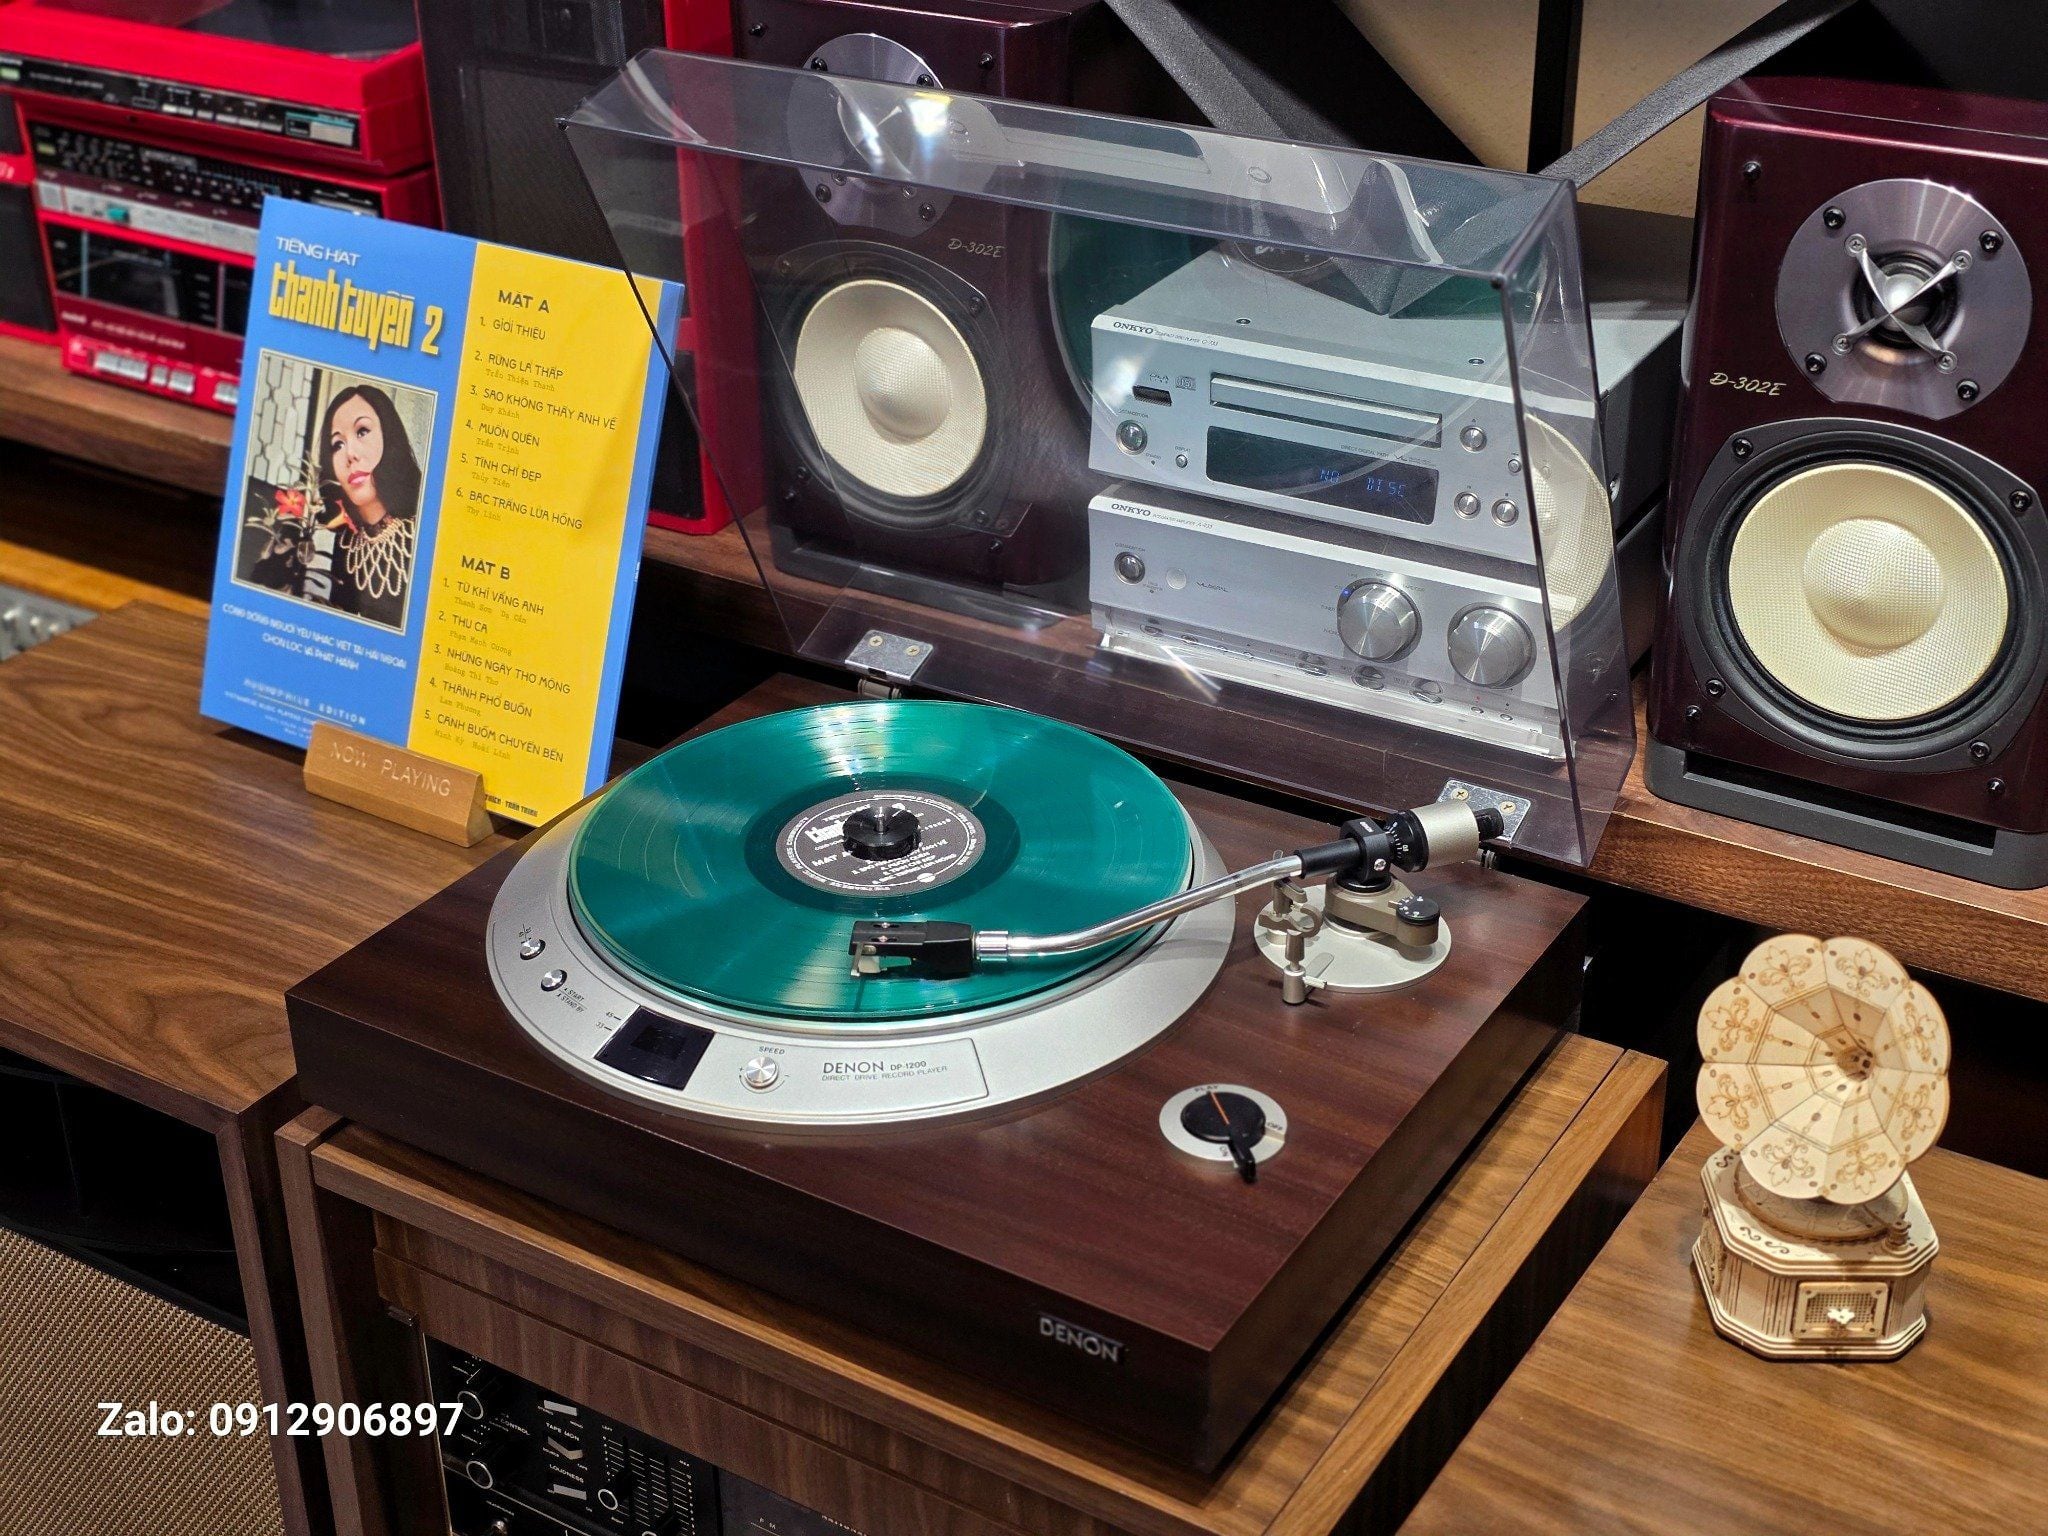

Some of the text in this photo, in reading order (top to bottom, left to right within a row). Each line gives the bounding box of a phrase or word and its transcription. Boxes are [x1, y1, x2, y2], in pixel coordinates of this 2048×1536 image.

[948, 238, 1005, 257] D-302E
[268, 259, 340, 330] thanh
[420, 305, 443, 355] 2
[538, 300, 549, 313] A
[1113, 321, 1154, 335] ONKYO
[474, 350, 483, 362] 2.
[1709, 372, 1787, 396] D-302E
[470, 385, 478, 396] 3.
[483, 388, 504, 402] SAO
[506, 393, 544, 412] KHÔNG
[577, 411, 600, 427] ANH
[465, 419, 473, 430] 4.
[461, 453, 468, 464] 5.
[456, 487, 464, 498] 6.
[1111, 503, 1151, 517] ONKYO
[500, 566, 511, 580] B
[521, 600, 544, 615] ANH
[438, 610, 488, 633] 2. THU CA
[434, 644, 441, 654] 3.
[429, 677, 437, 688] 4.
[319, 703, 366, 725] EDITION
[425, 709, 432, 720] 5.
[329, 742, 452, 797] NOW PLAYING
[569, 989, 585, 1002] START
[759, 1046, 785, 1055] SPEED
[822, 1074, 850, 1082] DIRECT
[881, 1071, 915, 1079] RECORD
[917, 1066, 948, 1076] PLAYER
[823, 1061, 884, 1074] DENON
[1040, 1317, 1118, 1362] DENON
[546, 1421, 562, 1434] TAPE
[549, 1463, 585, 1484] LOUDNESS
